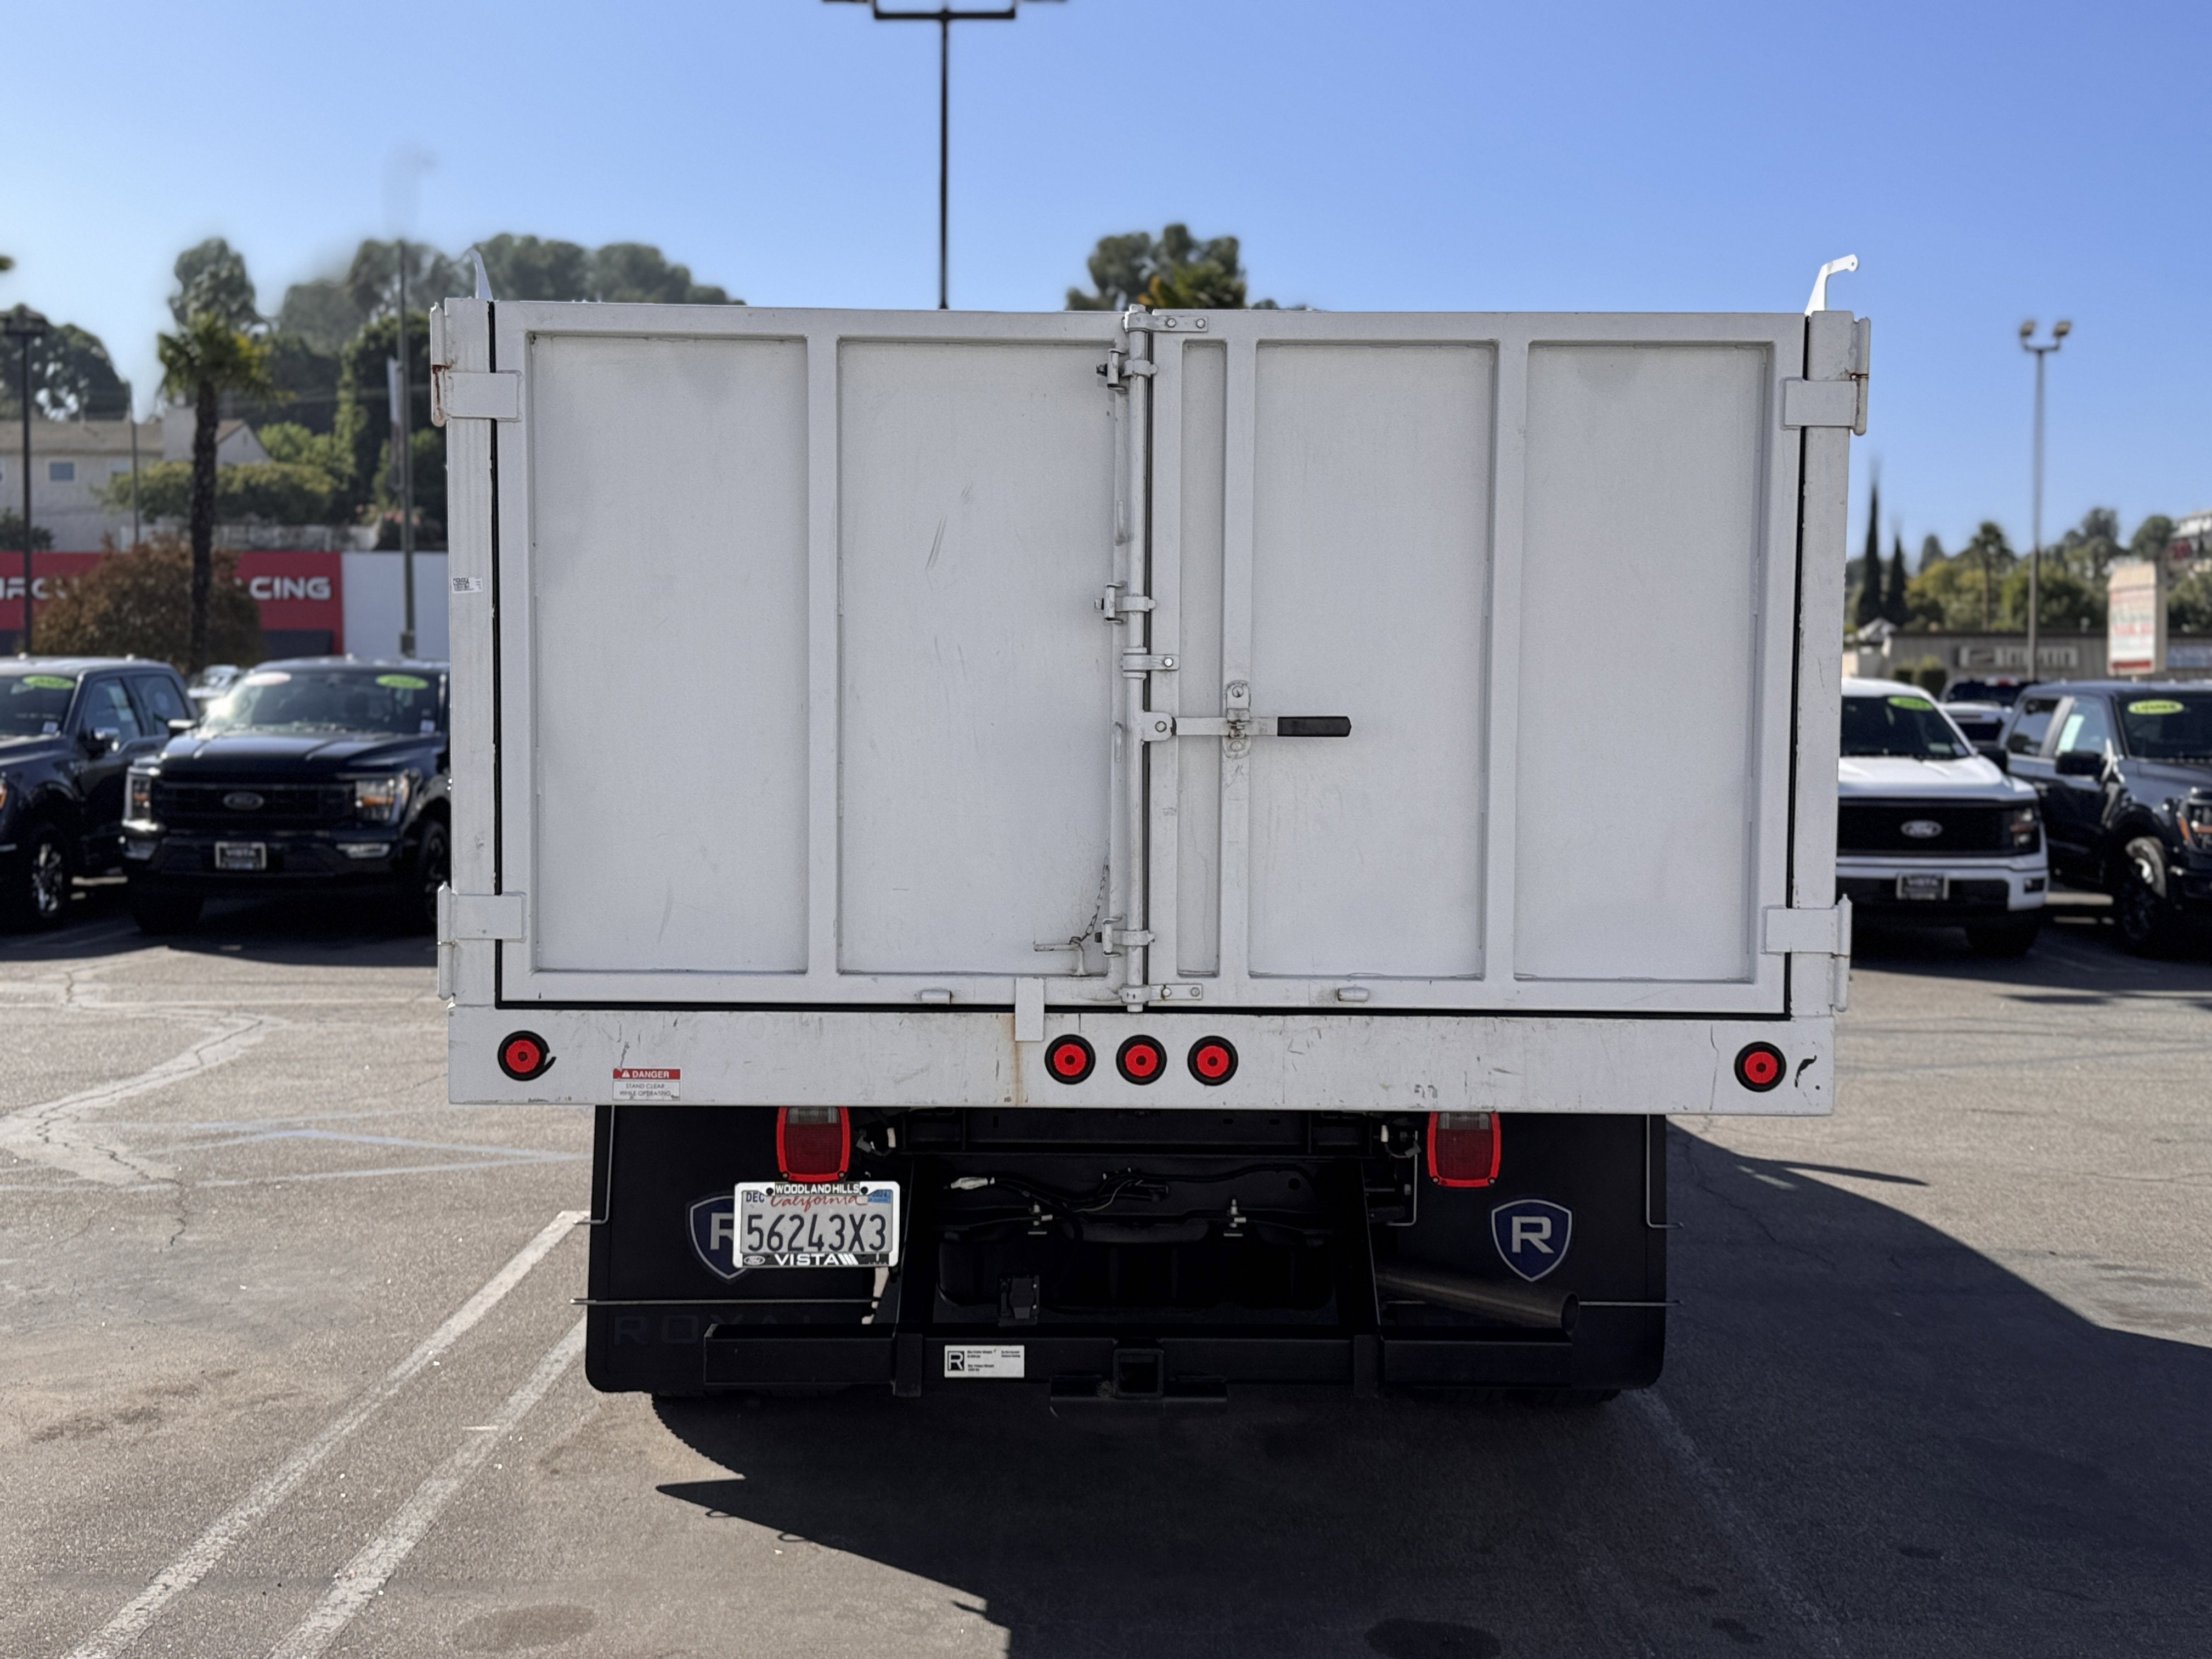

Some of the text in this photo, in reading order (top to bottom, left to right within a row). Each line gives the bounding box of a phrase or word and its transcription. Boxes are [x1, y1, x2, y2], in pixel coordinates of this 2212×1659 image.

[746, 1192, 765, 1203] DEC
[770, 1195, 868, 1212] California
[747, 1213, 887, 1252] 56243X3
[1511, 1216, 1554, 1254] R
[774, 1253, 839, 1266] VISTA
[949, 1352, 964, 1370] R
